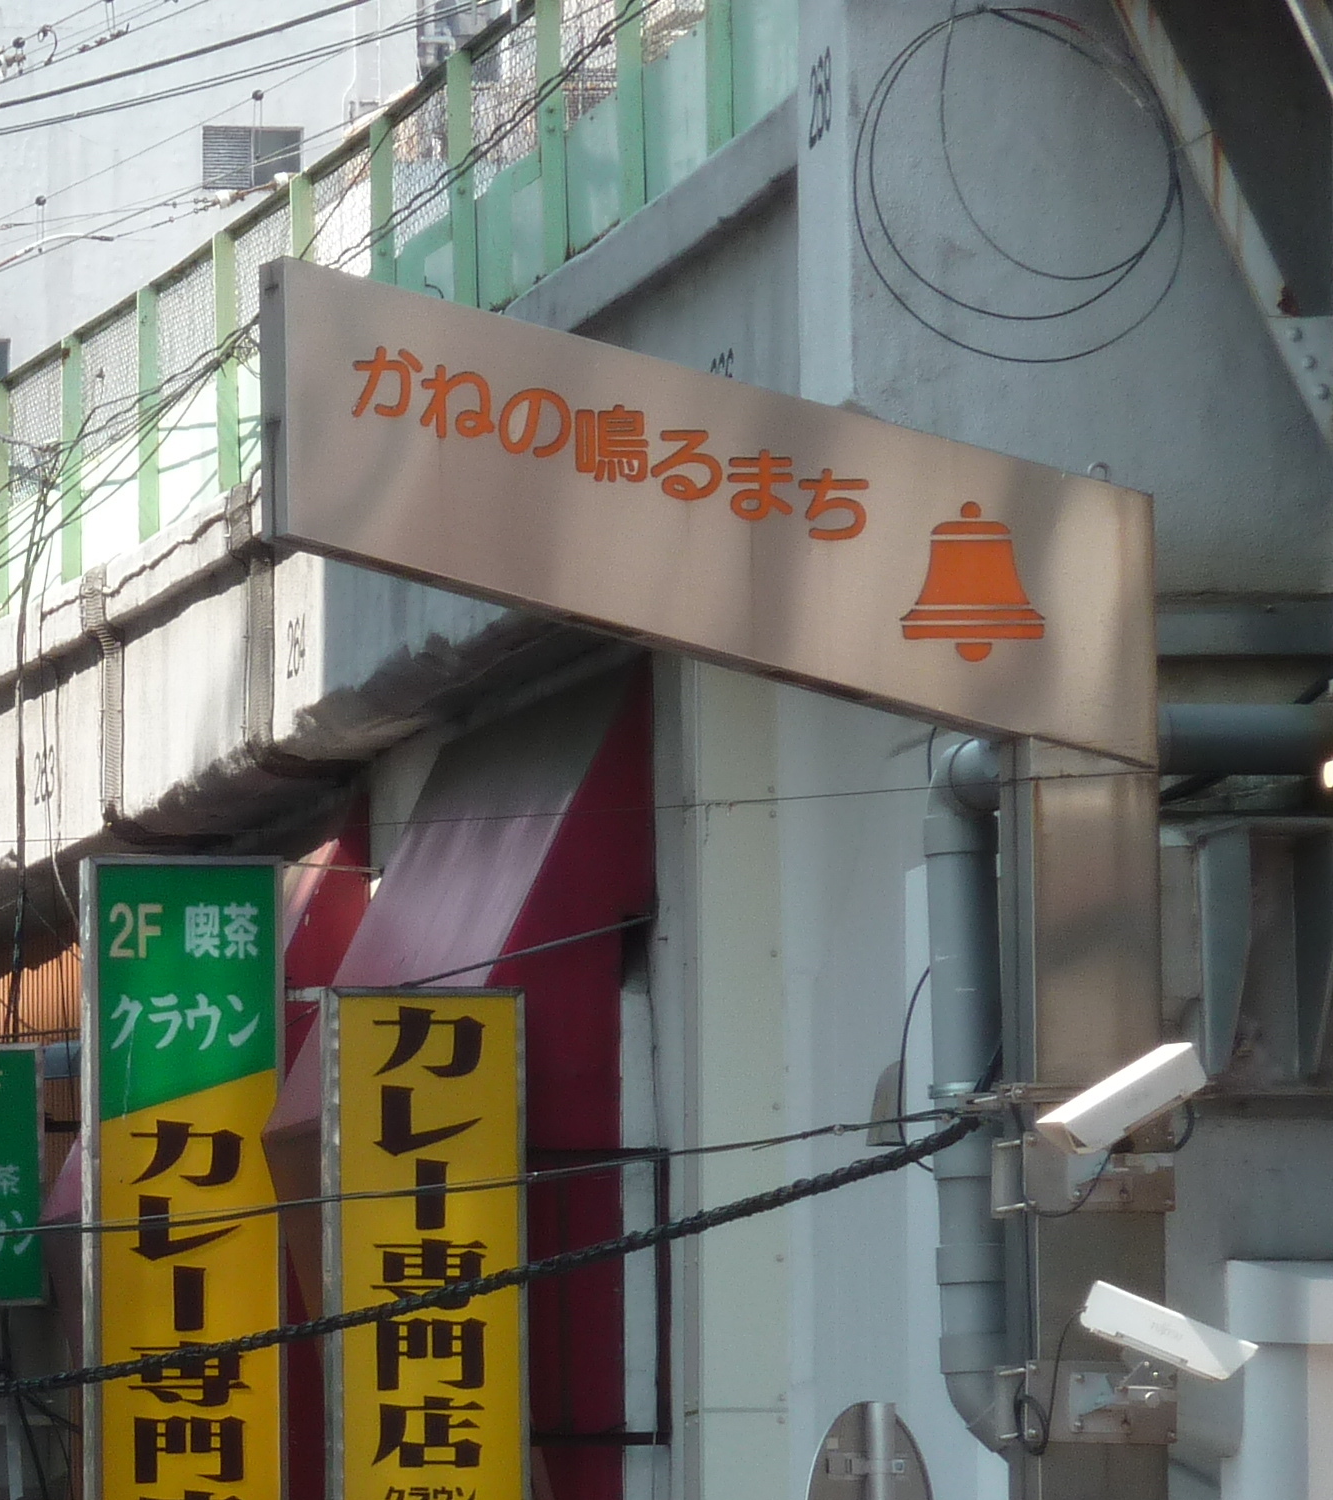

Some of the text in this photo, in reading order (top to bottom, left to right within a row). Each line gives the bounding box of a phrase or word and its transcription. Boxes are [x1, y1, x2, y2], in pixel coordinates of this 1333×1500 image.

[351, 346, 870, 541] かねの鳴るまち
[109, 902, 261, 958] 2F 喫茶
[110, 994, 262, 1052] クラウン
[370, 1006, 488, 1469] カレー専門店
